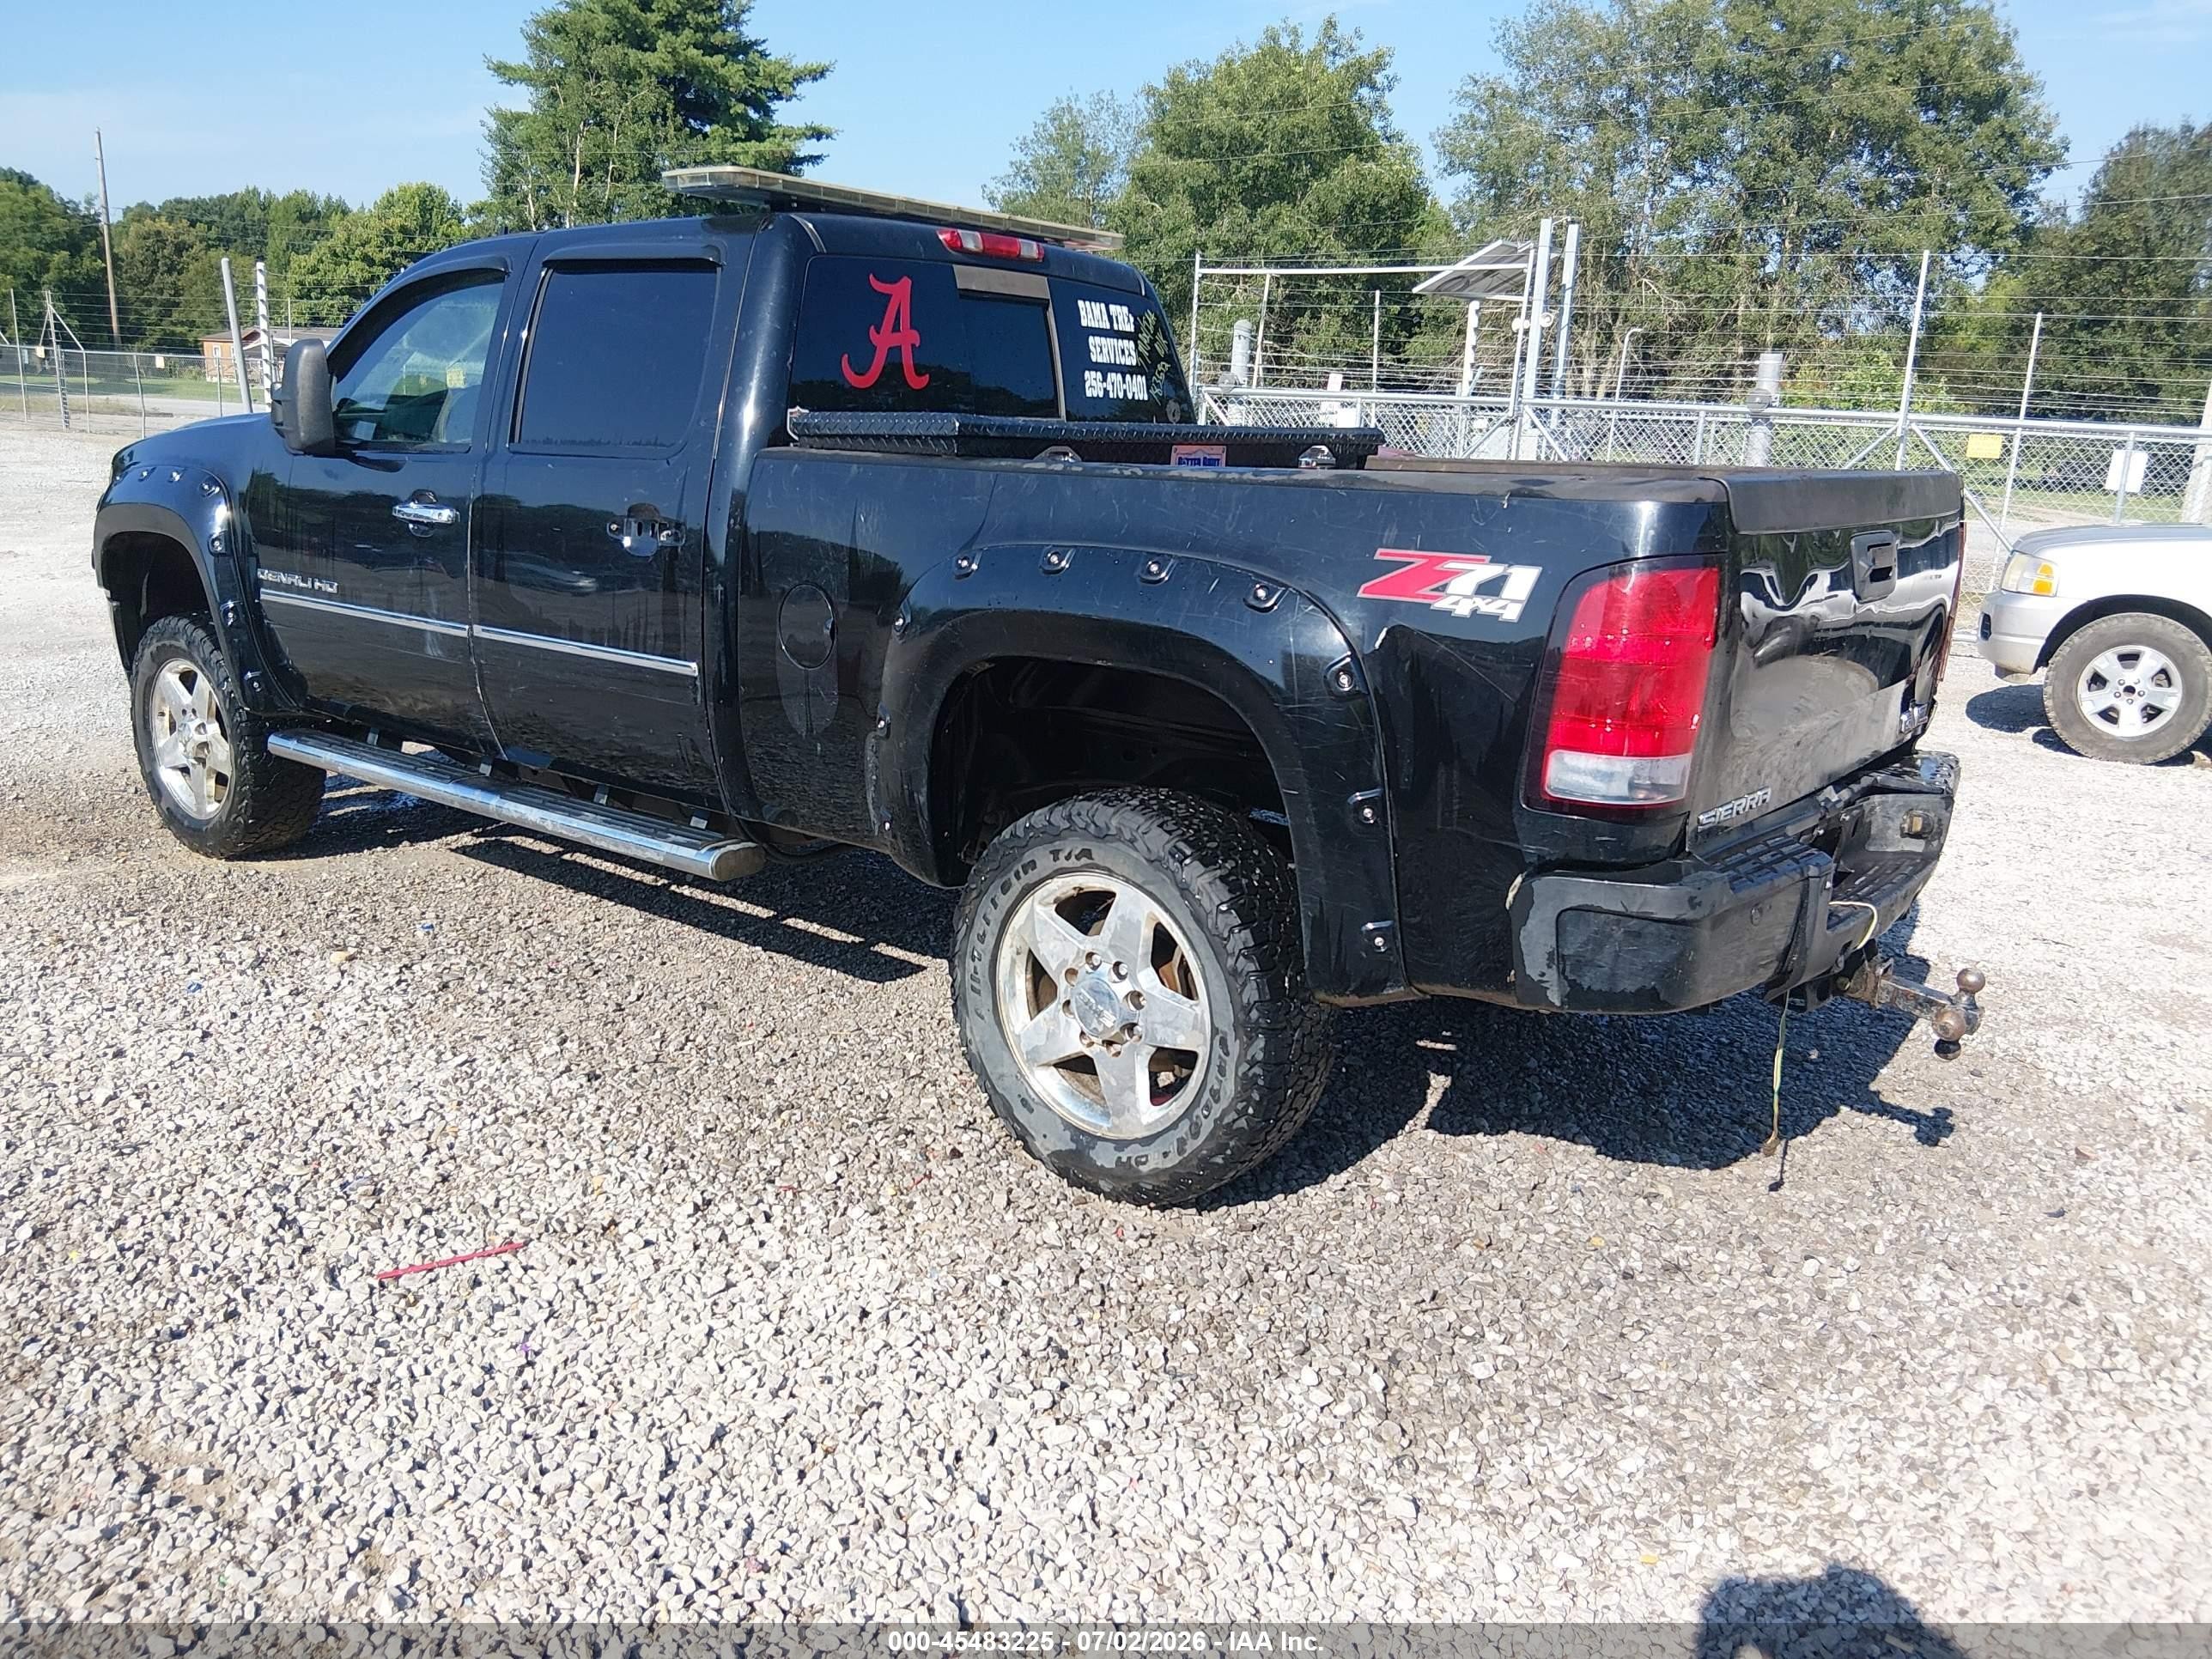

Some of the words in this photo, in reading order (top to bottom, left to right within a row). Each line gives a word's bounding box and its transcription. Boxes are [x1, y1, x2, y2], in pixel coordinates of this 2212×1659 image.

[1078, 300, 1109, 329] BAMA
[841, 272, 930, 391] A
[1088, 336, 1136, 366] SERVICES
[1084, 370, 1148, 401] 256-470-0401
[257, 568, 312, 589] DENALI
[313, 578, 338, 593] HD
[1357, 548, 1544, 604] Z71
[1697, 786, 1771, 826] SIERRA
[1048, 848, 1095, 863] T/A
